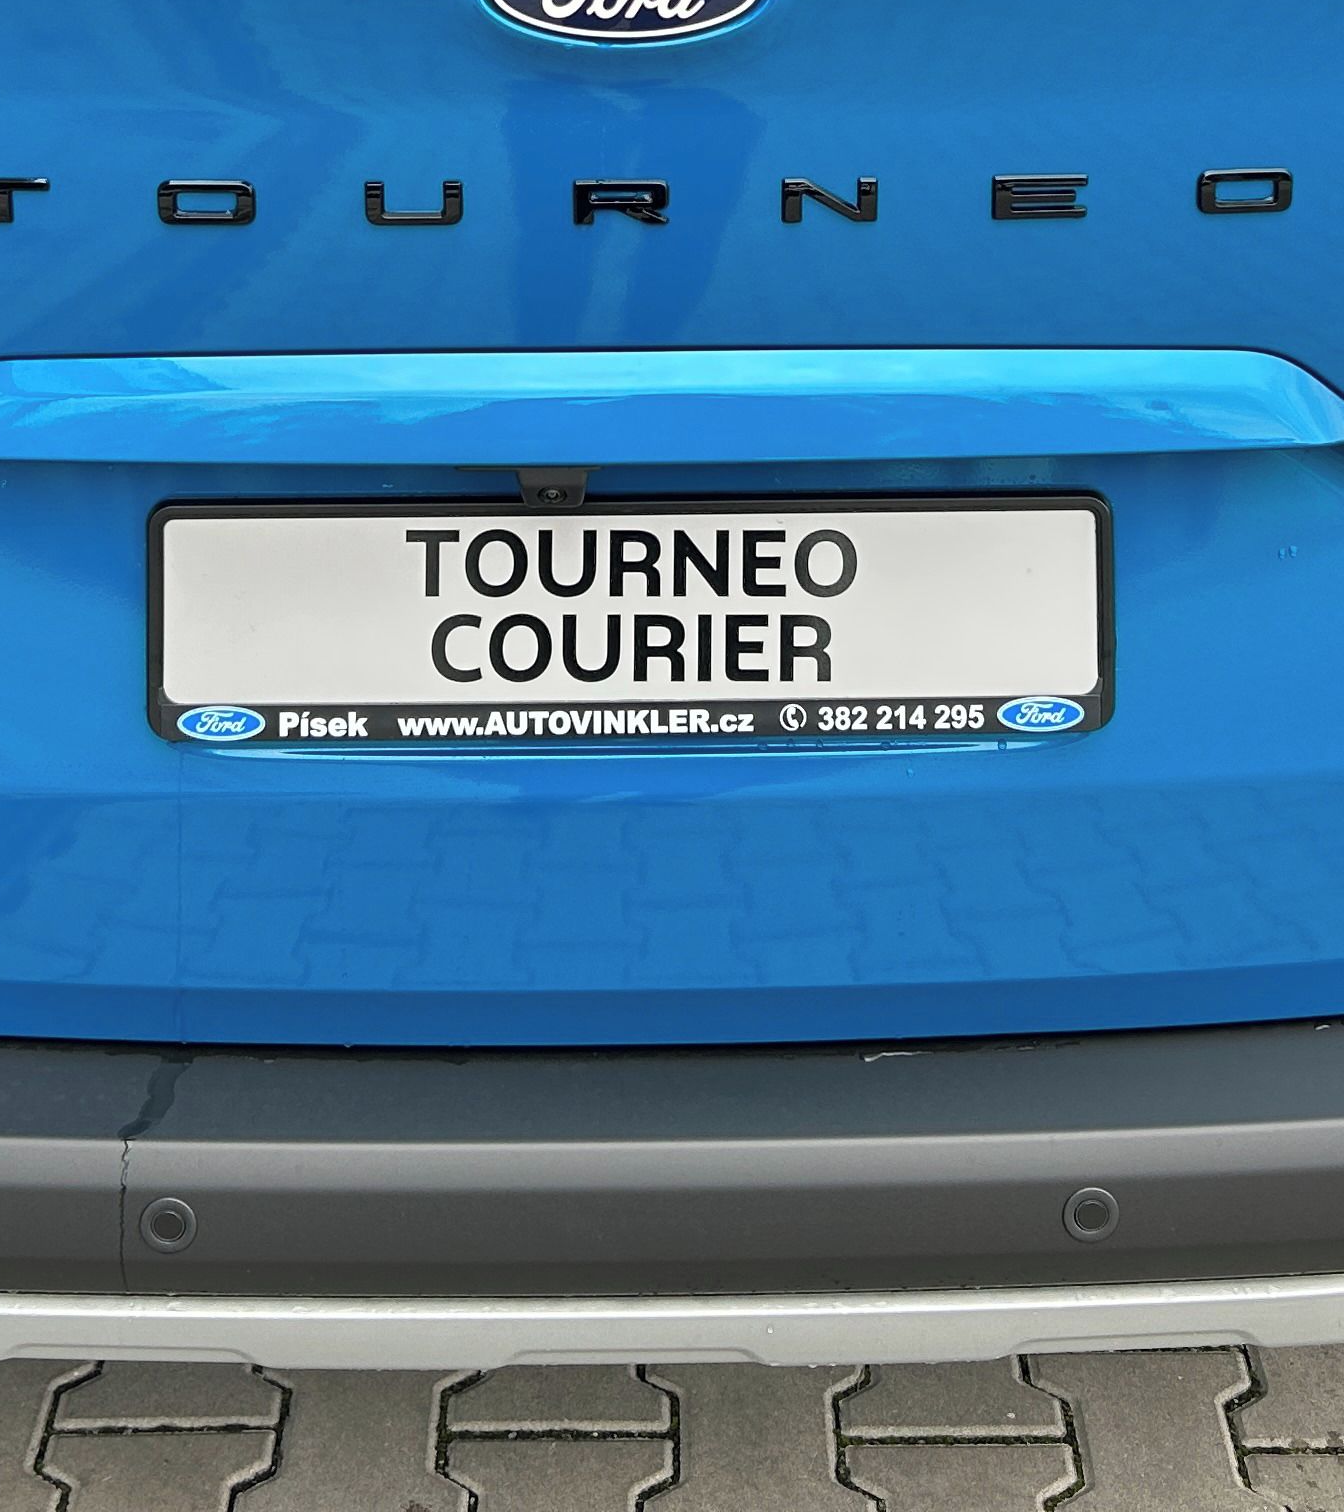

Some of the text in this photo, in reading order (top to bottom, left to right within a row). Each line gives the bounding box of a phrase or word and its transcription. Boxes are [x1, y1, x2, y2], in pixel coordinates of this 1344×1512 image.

[405, 528, 858, 598] TOURNEO
[430, 613, 832, 683] COURIER
[195, 703, 1066, 738] Ford Písek www.AUTOVINKLER.cz 382 214 295 Ford
